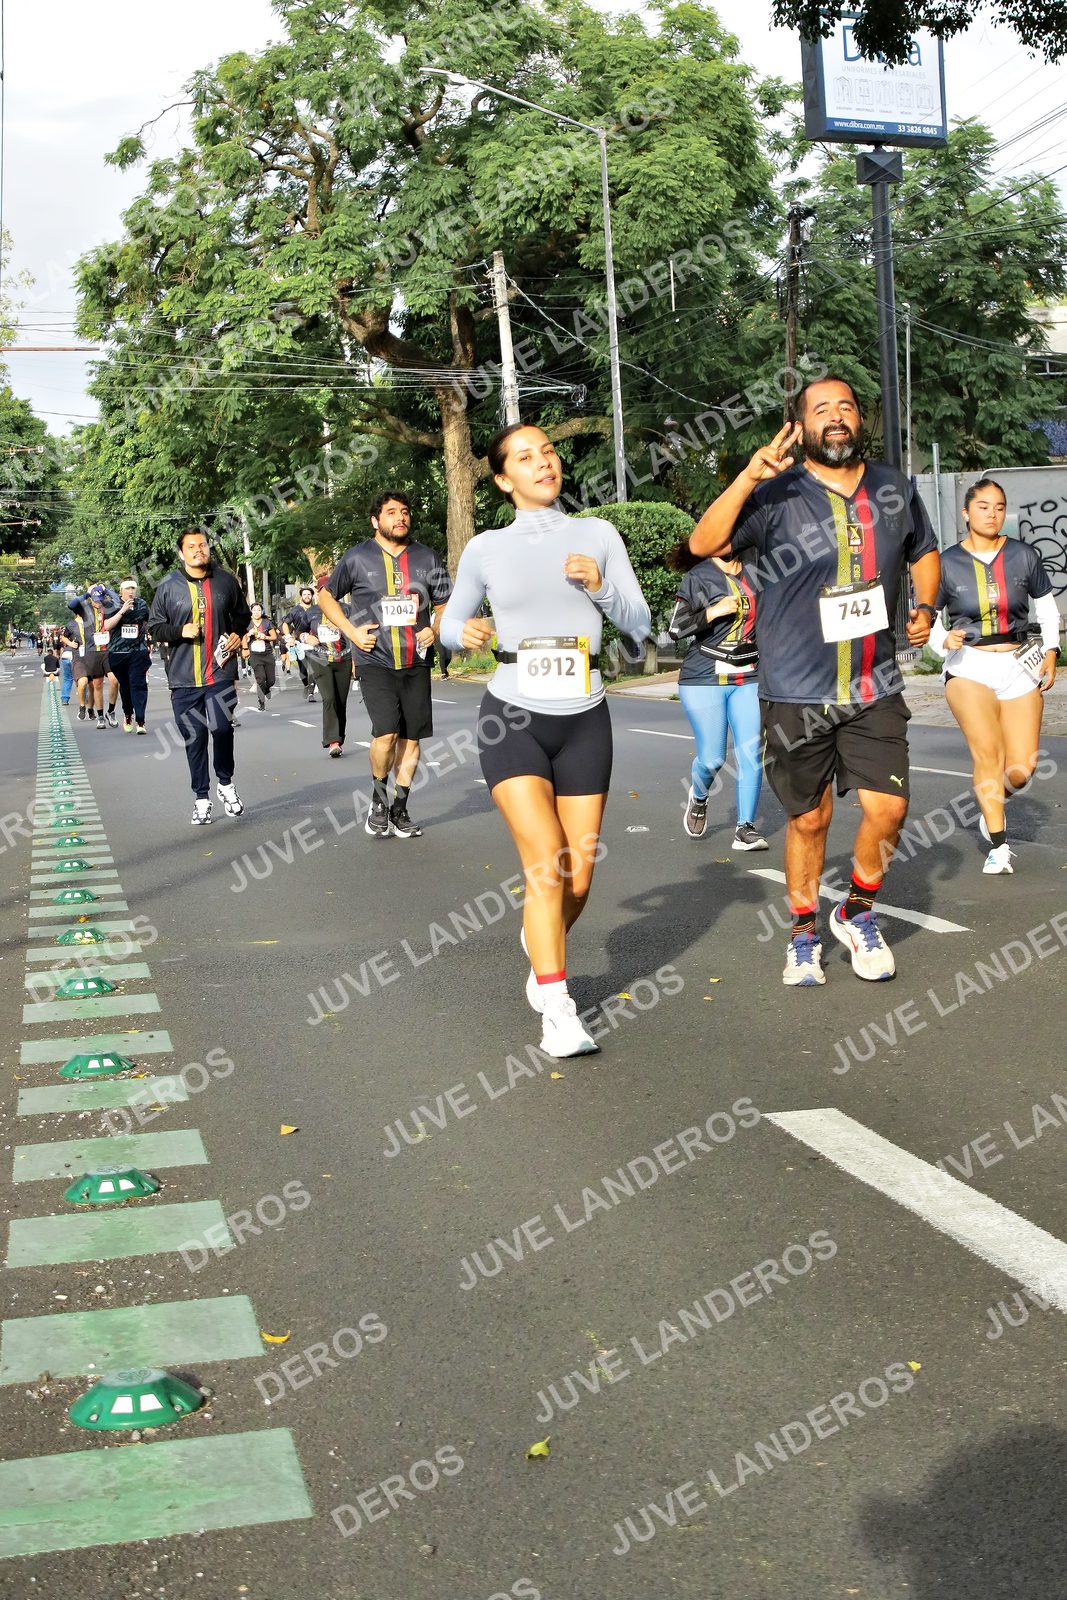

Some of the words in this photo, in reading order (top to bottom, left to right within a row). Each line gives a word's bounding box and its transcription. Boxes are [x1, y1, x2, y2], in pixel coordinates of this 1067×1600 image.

[898, 124, 906, 132] 33
[907, 125, 921, 133] 3826
[923, 126, 937, 135] 4845
[1019, 497, 1067, 516] TO
[384, 605, 414, 615] 12042
[839, 598, 871, 620] 742
[528, 657, 575, 676] 6912
